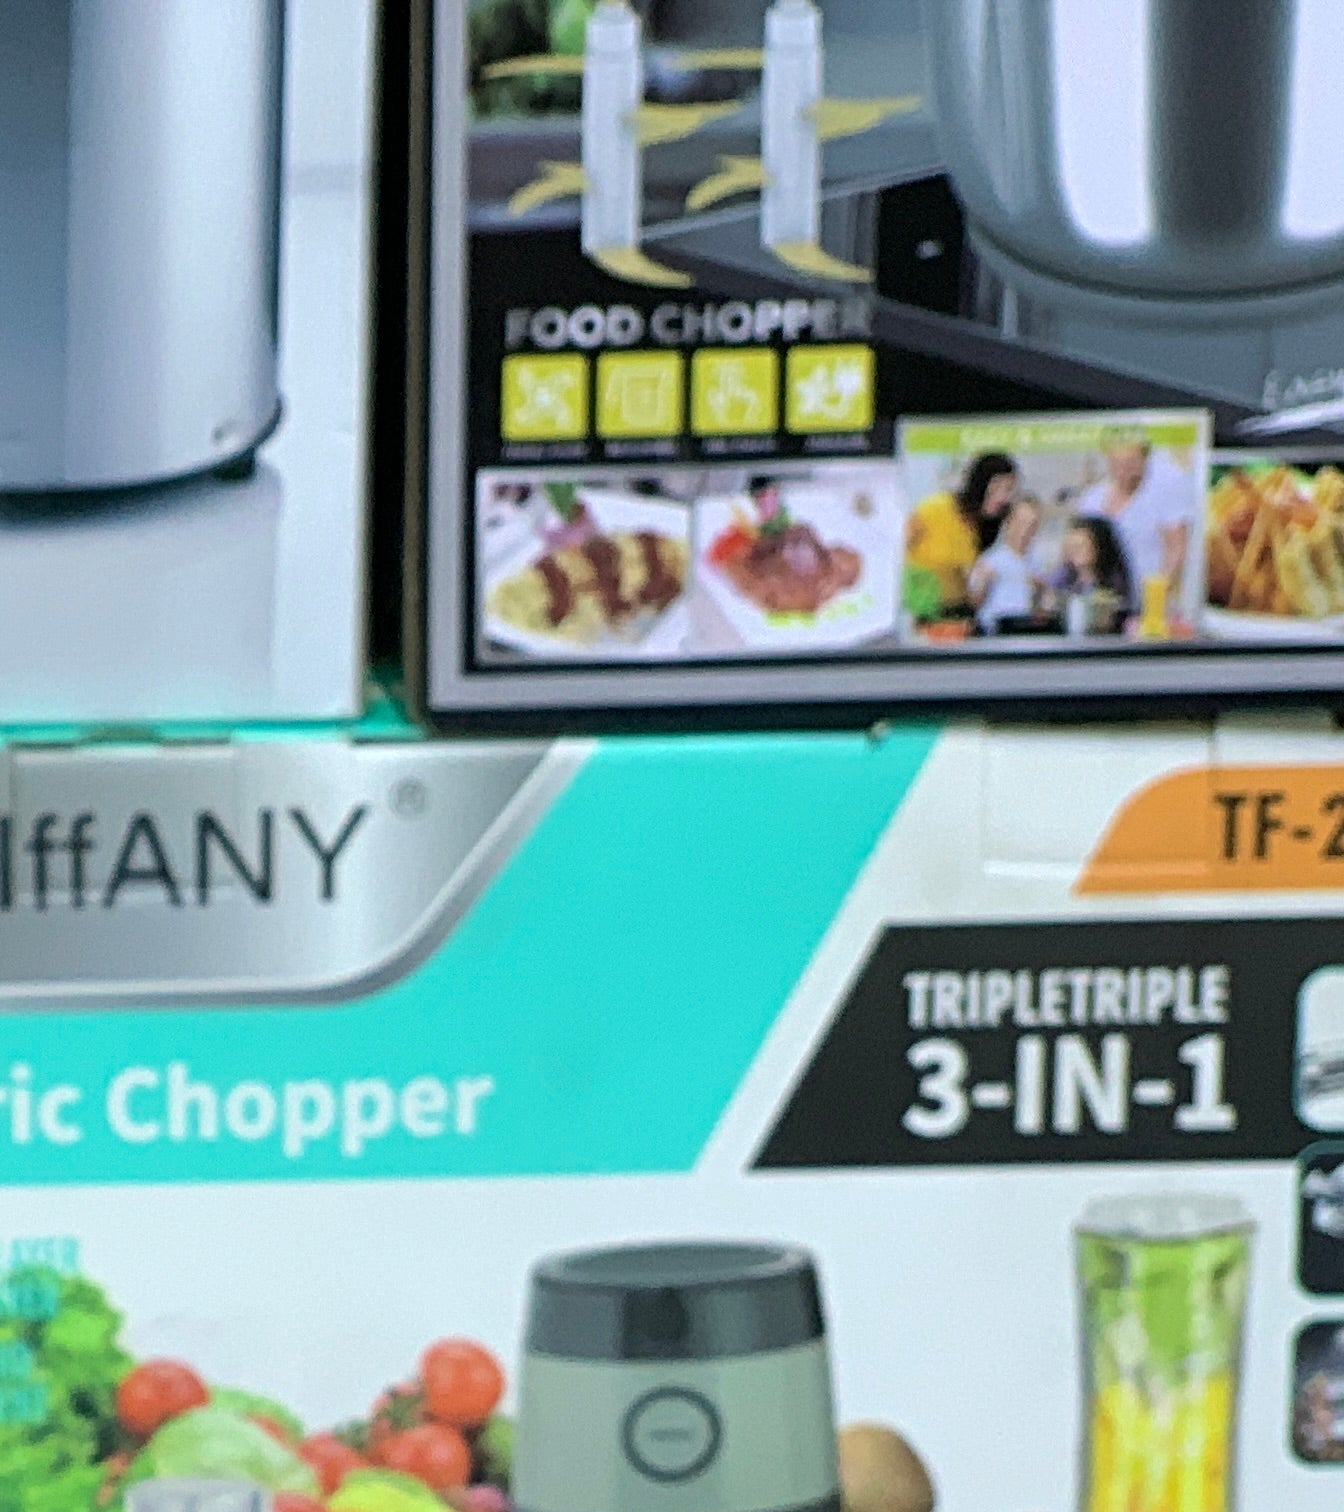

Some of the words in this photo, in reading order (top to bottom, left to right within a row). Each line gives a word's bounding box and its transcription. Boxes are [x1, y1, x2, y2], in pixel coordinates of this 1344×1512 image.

[505, 303, 646, 349] FOOD
[650, 299, 873, 344] CHOPPER
[902, 964, 1232, 1029] TRIPLETRIPLE
[106, 1061, 494, 1158] Chopper
[901, 1033, 1237, 1140] 3-IN-1
